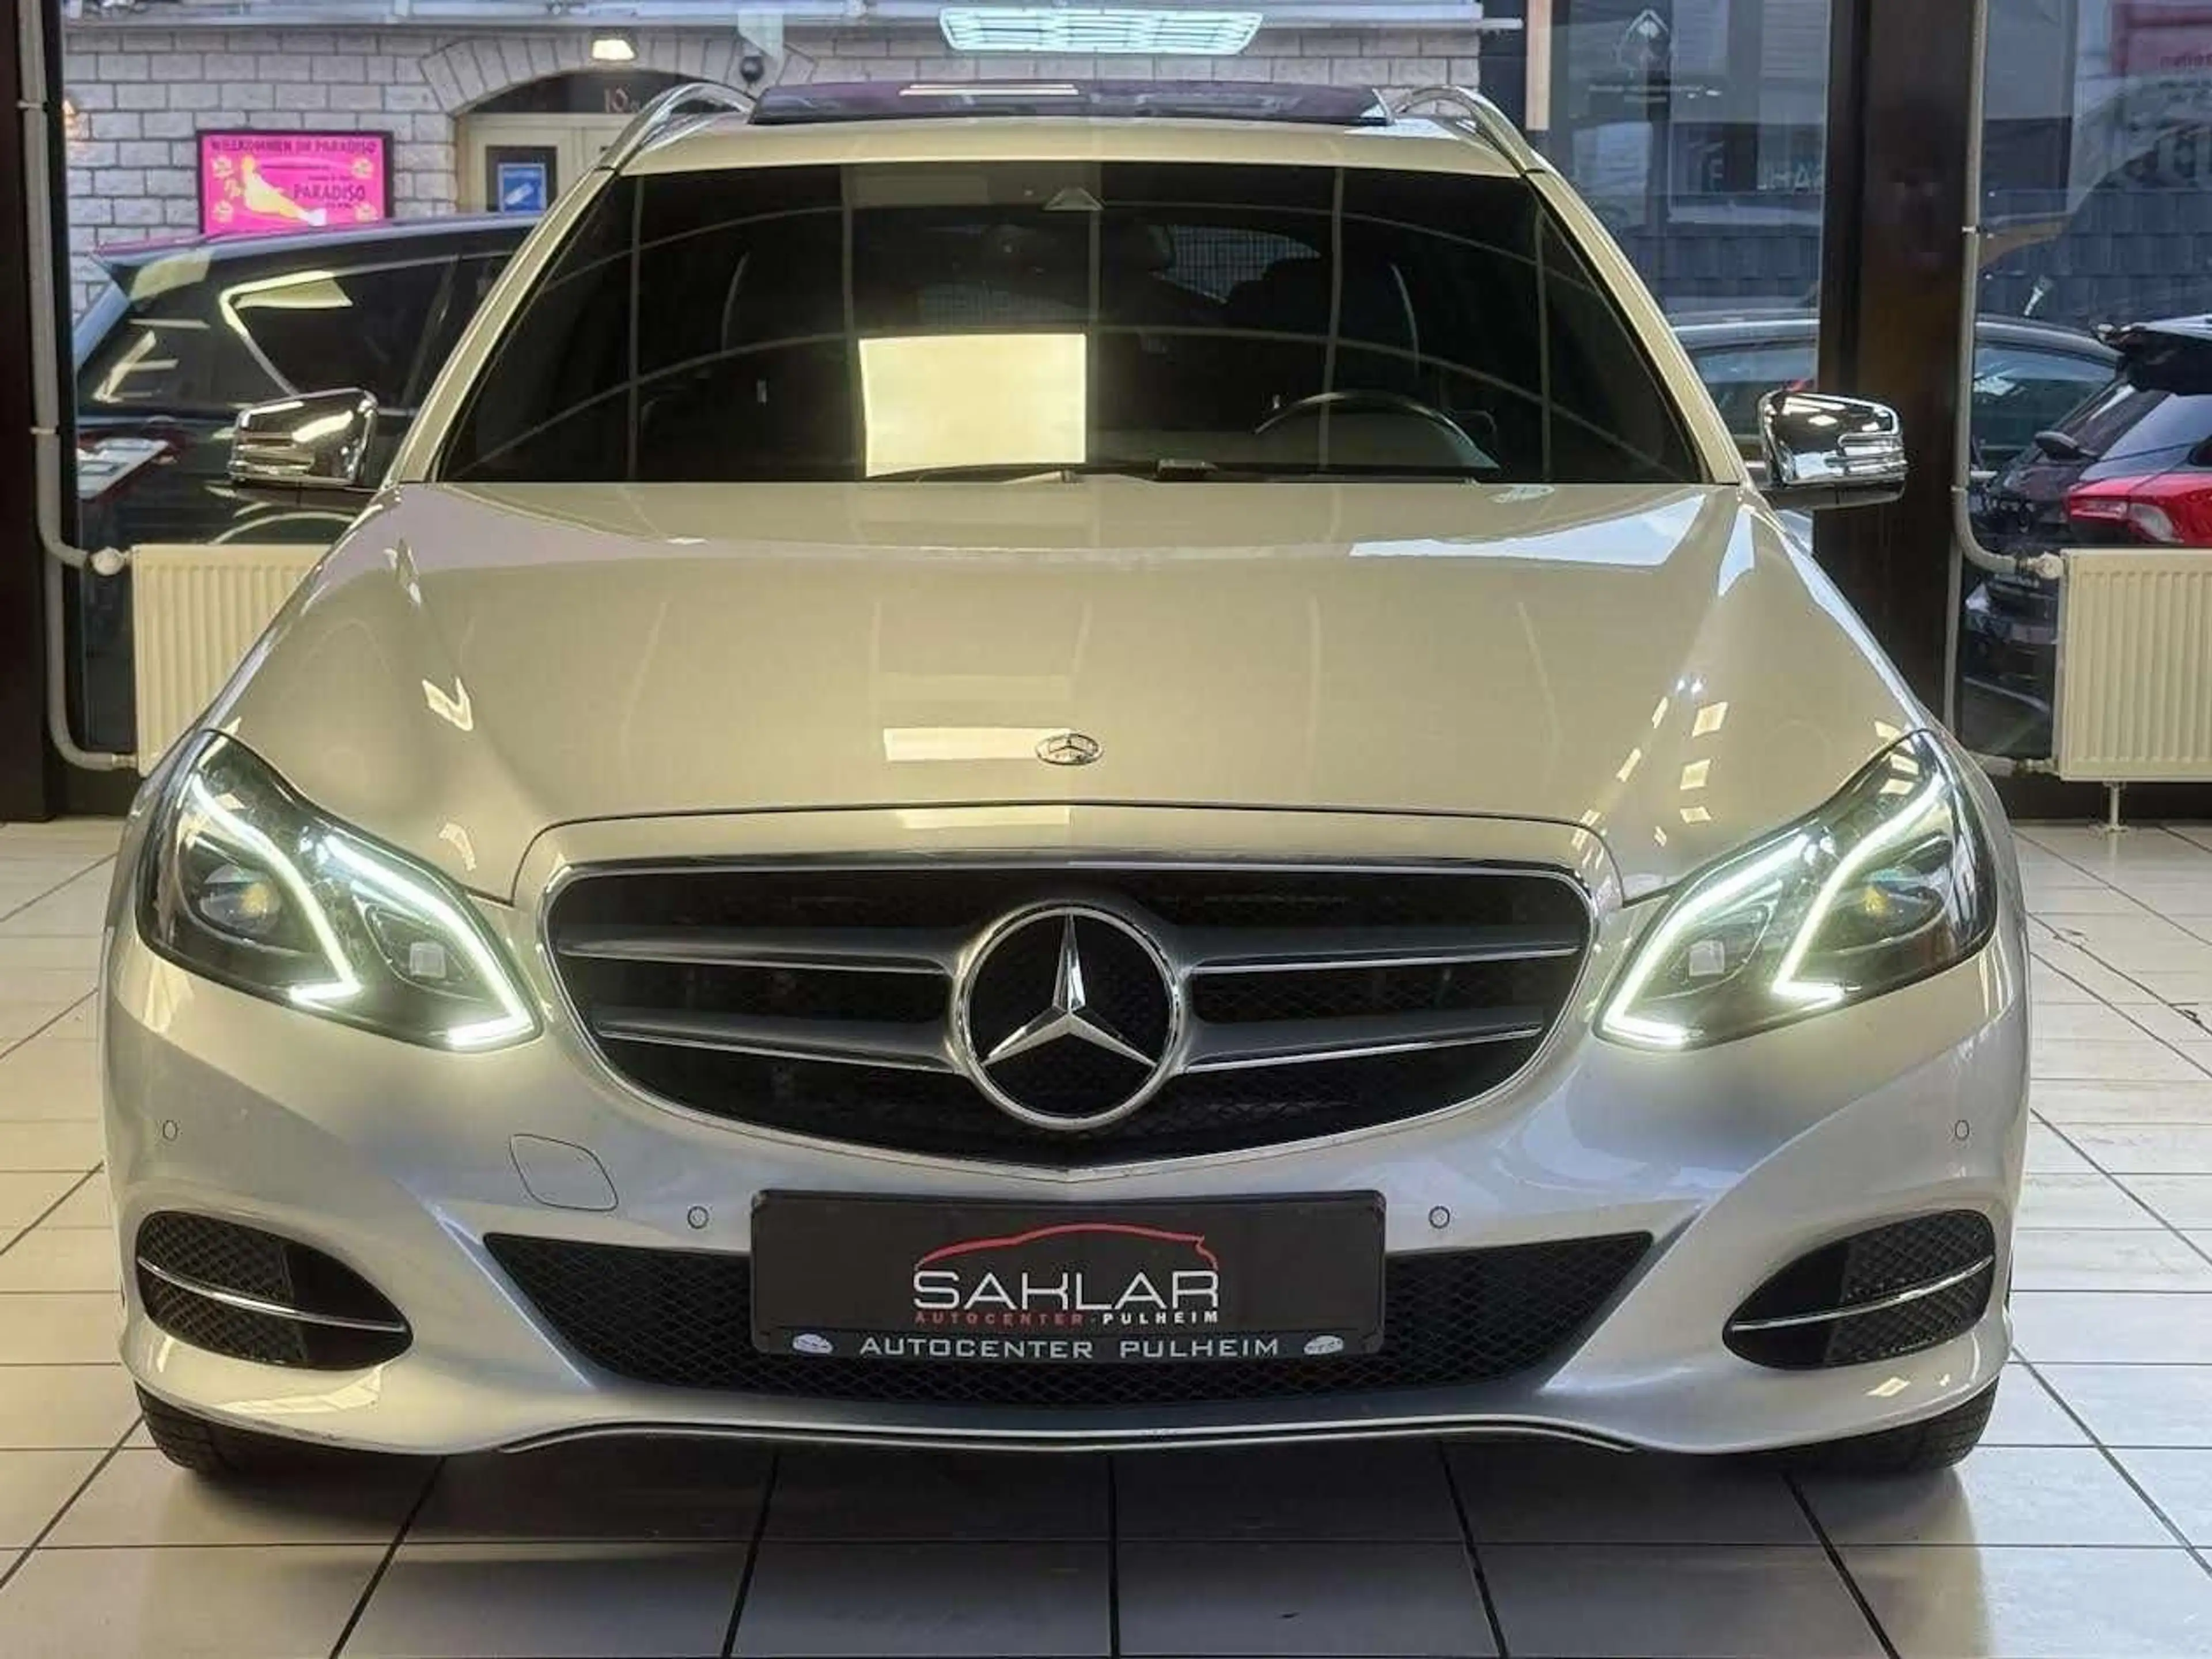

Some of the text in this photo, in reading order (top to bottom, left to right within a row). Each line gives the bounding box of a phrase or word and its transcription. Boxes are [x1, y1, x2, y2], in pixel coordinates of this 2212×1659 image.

[915, 1311, 1218, 1325] AUTOCENTER PULHEIM
[859, 1337, 1278, 1358] AUTOCENTER PULHEIM
